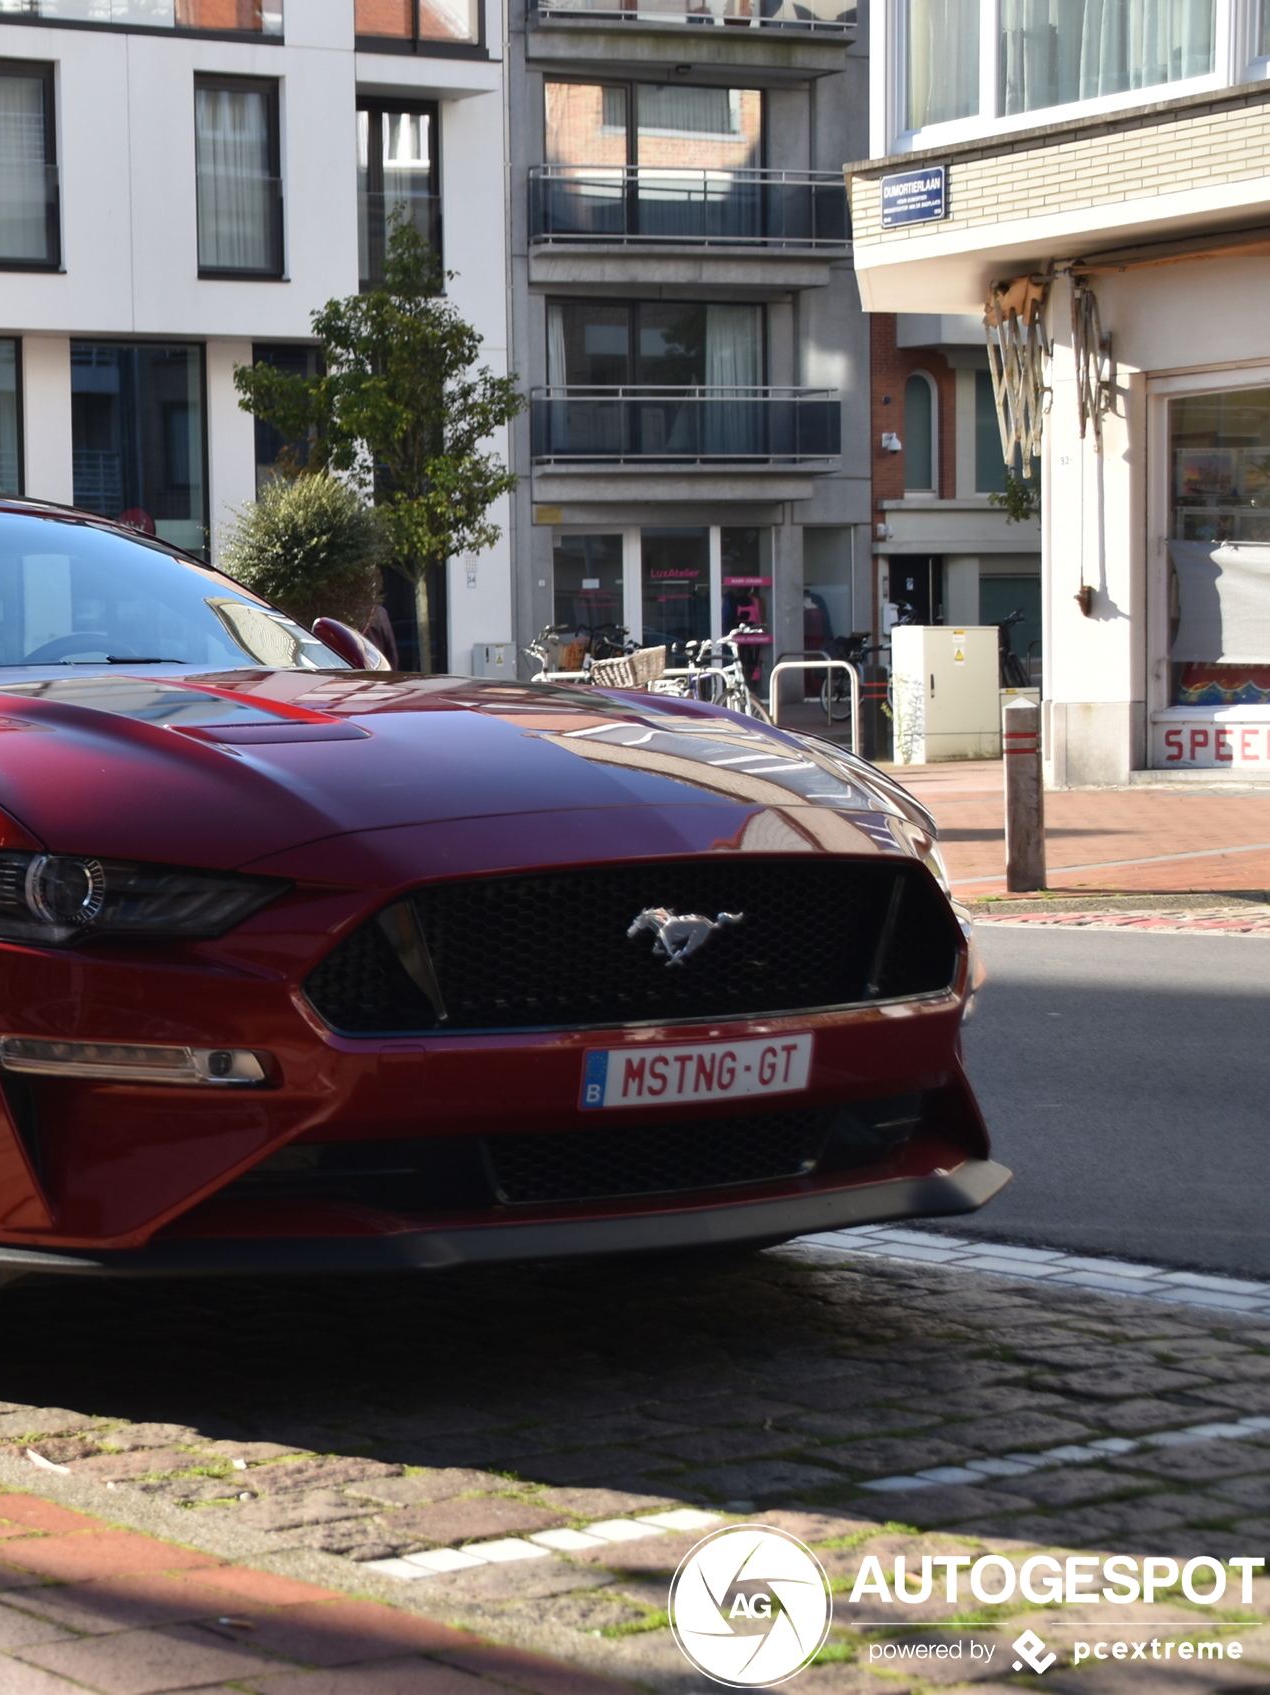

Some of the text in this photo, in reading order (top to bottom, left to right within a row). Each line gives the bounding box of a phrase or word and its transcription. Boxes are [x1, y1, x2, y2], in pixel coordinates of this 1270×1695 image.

[883, 177, 941, 199] DUMORTIERLAAN
[650, 568, 700, 579] LuxAtelier
[586, 1044, 797, 1103] B MSTNG-GT
